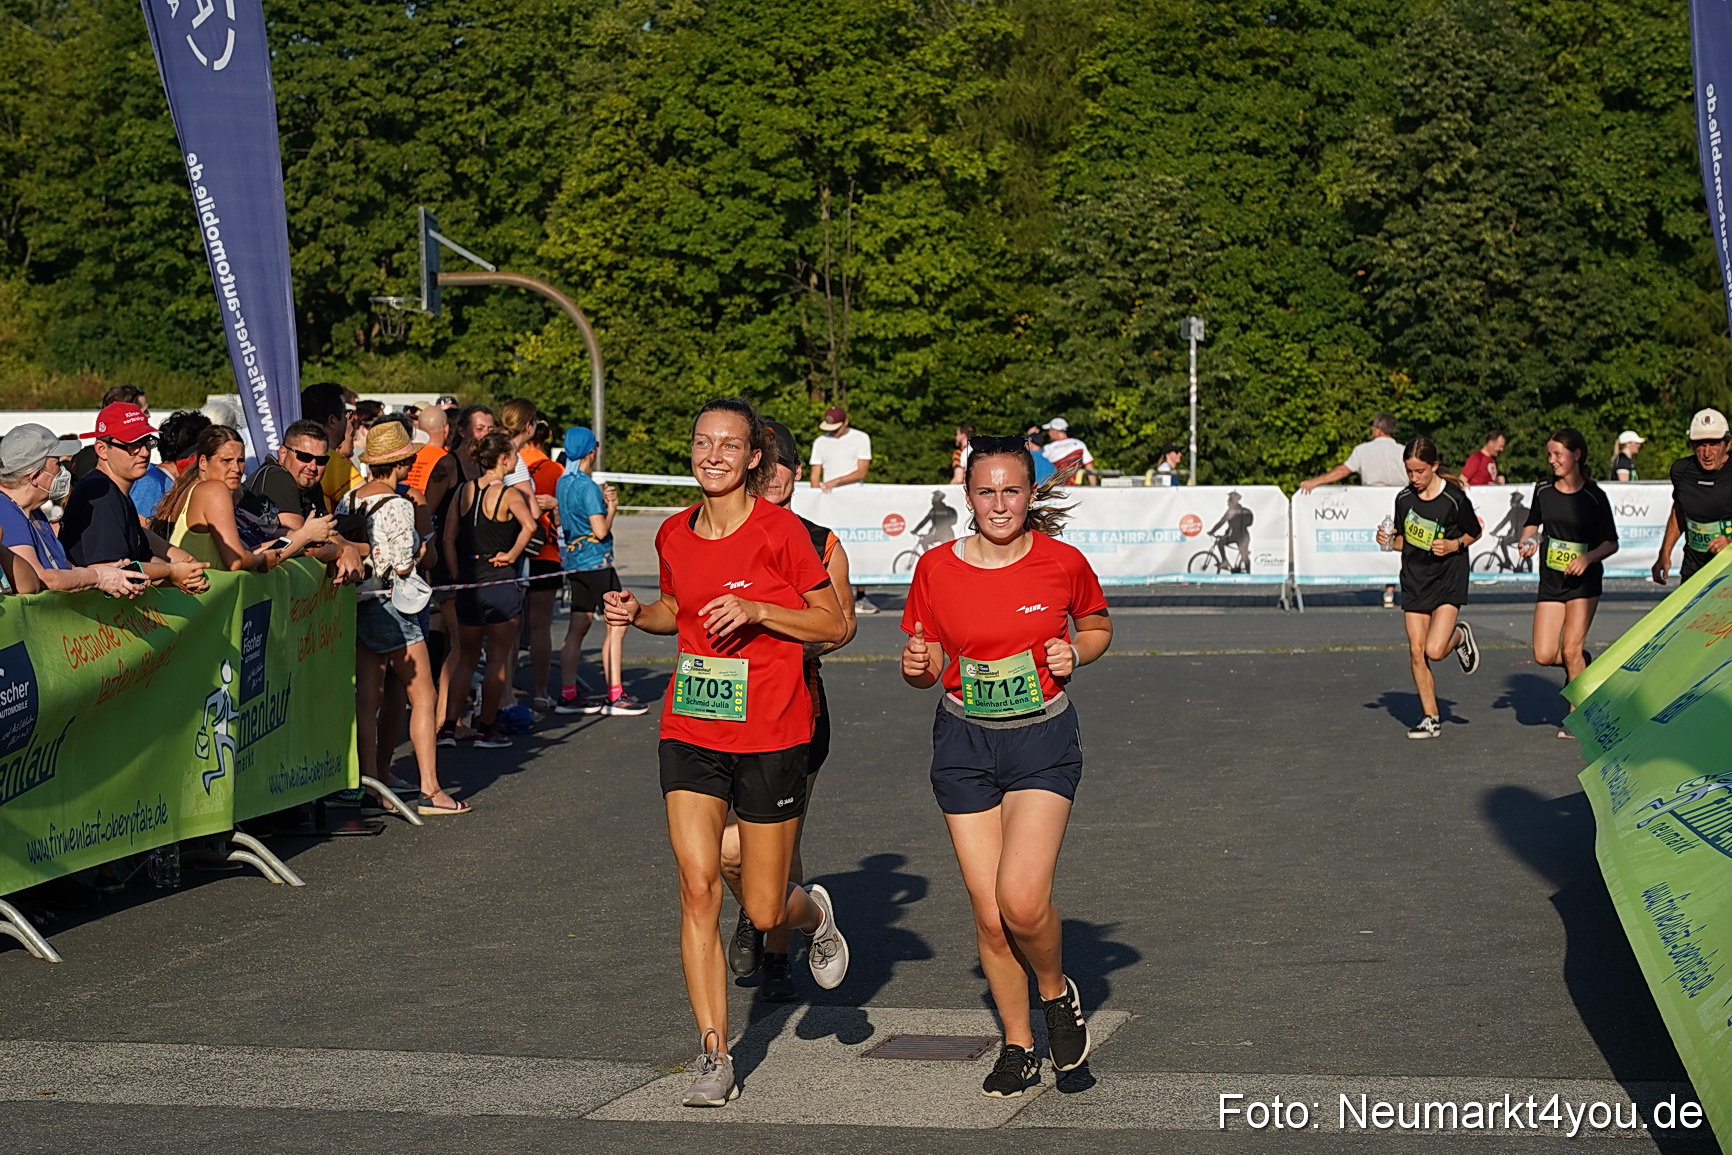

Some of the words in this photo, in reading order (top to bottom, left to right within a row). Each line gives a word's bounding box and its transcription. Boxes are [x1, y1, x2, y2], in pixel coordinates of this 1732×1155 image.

[1315, 508, 1349, 520] NOW
[1614, 505, 1649, 517] NOW
[1317, 531, 1369, 542] E-BIKES
[1408, 523, 1425, 538] 498
[0, 680, 30, 707] scher
[676, 681, 684, 702] RUN
[685, 676, 733, 700] 1703
[965, 684, 974, 704] RUN
[974, 676, 1027, 699] 1712
[1027, 675, 1040, 703] 2022
[686, 697, 710, 707] Schmid
[734, 684, 743, 712] 2022
[975, 699, 1008, 708] Deinhard
[1010, 697, 1029, 706] Lena
[27, 793, 168, 864] www.firmenlauf-oberpfalz.de
